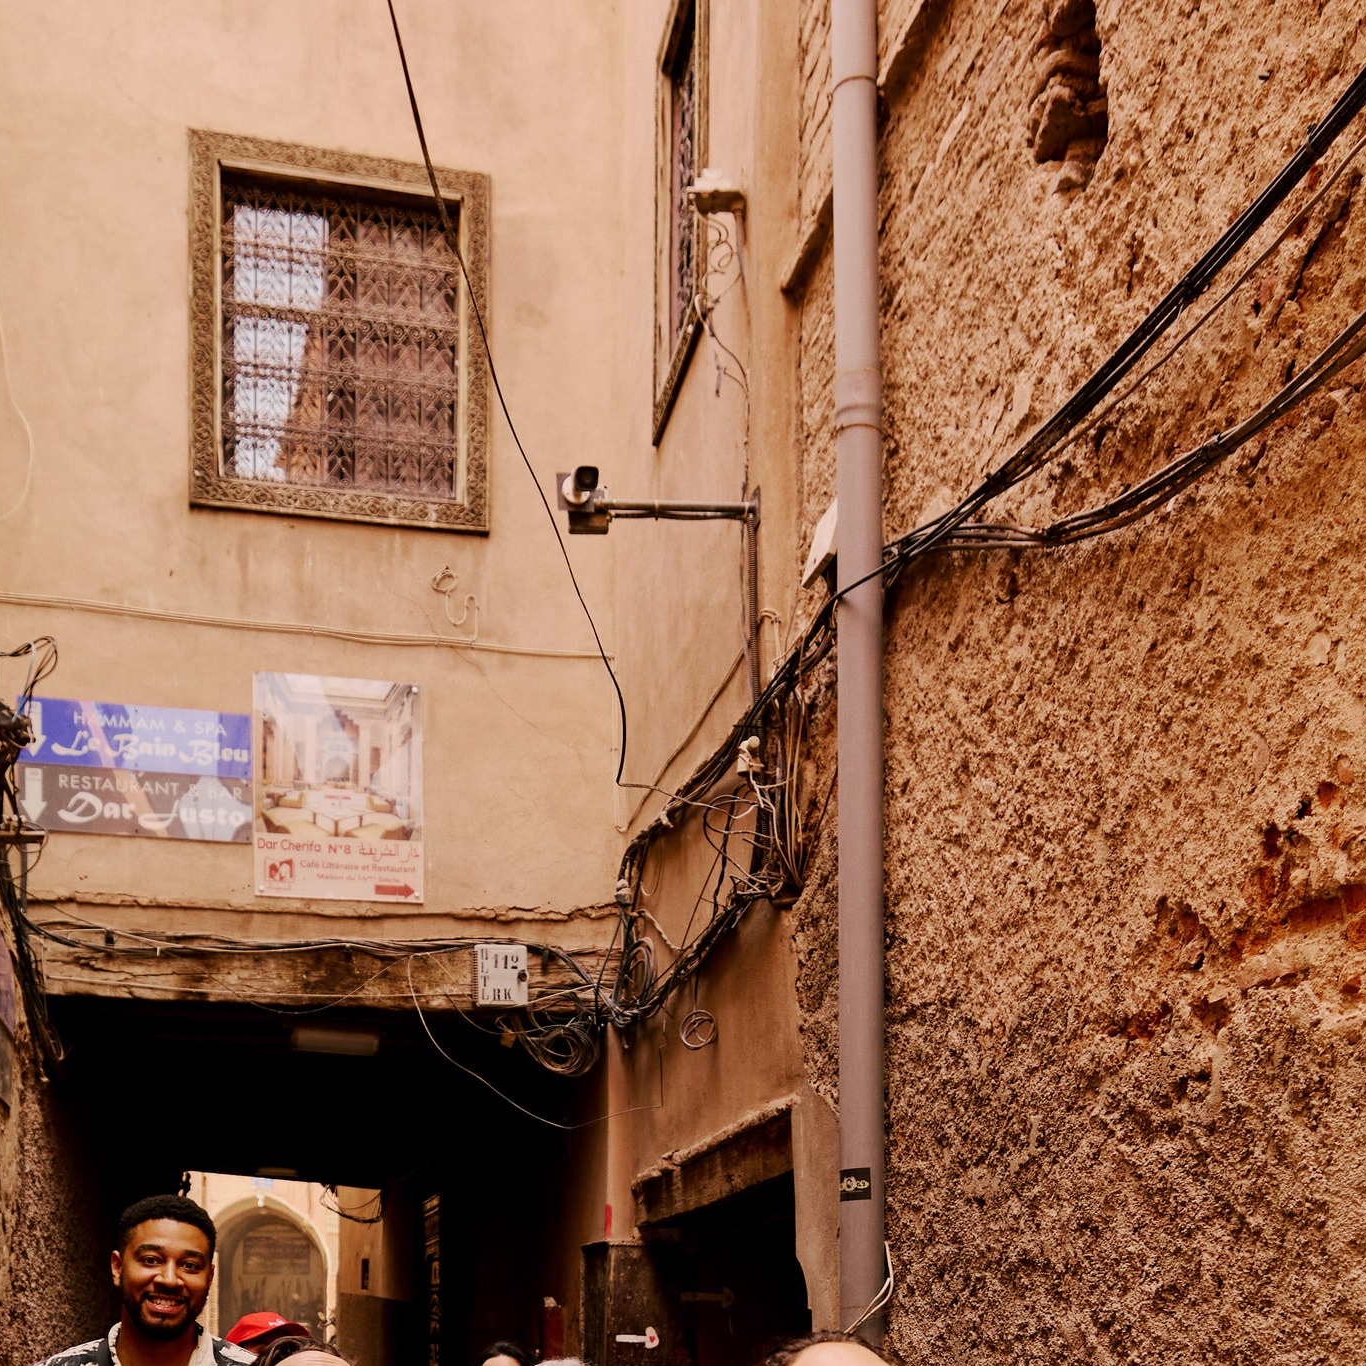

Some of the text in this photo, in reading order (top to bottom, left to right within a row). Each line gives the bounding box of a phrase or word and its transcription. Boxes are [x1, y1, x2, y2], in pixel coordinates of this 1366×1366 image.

[73, 710, 228, 737] HAMMAM & SPA
[50, 730, 250, 767] Le Bain Bleu
[58, 773, 180, 796] RESTAURANT
[207, 785, 243, 801] BAR
[57, 791, 247, 831] Dar Justo
[257, 837, 352, 855] Dar Cherifa N°8
[299, 859, 320, 869] Café
[371, 863, 417, 874] Restaurant
